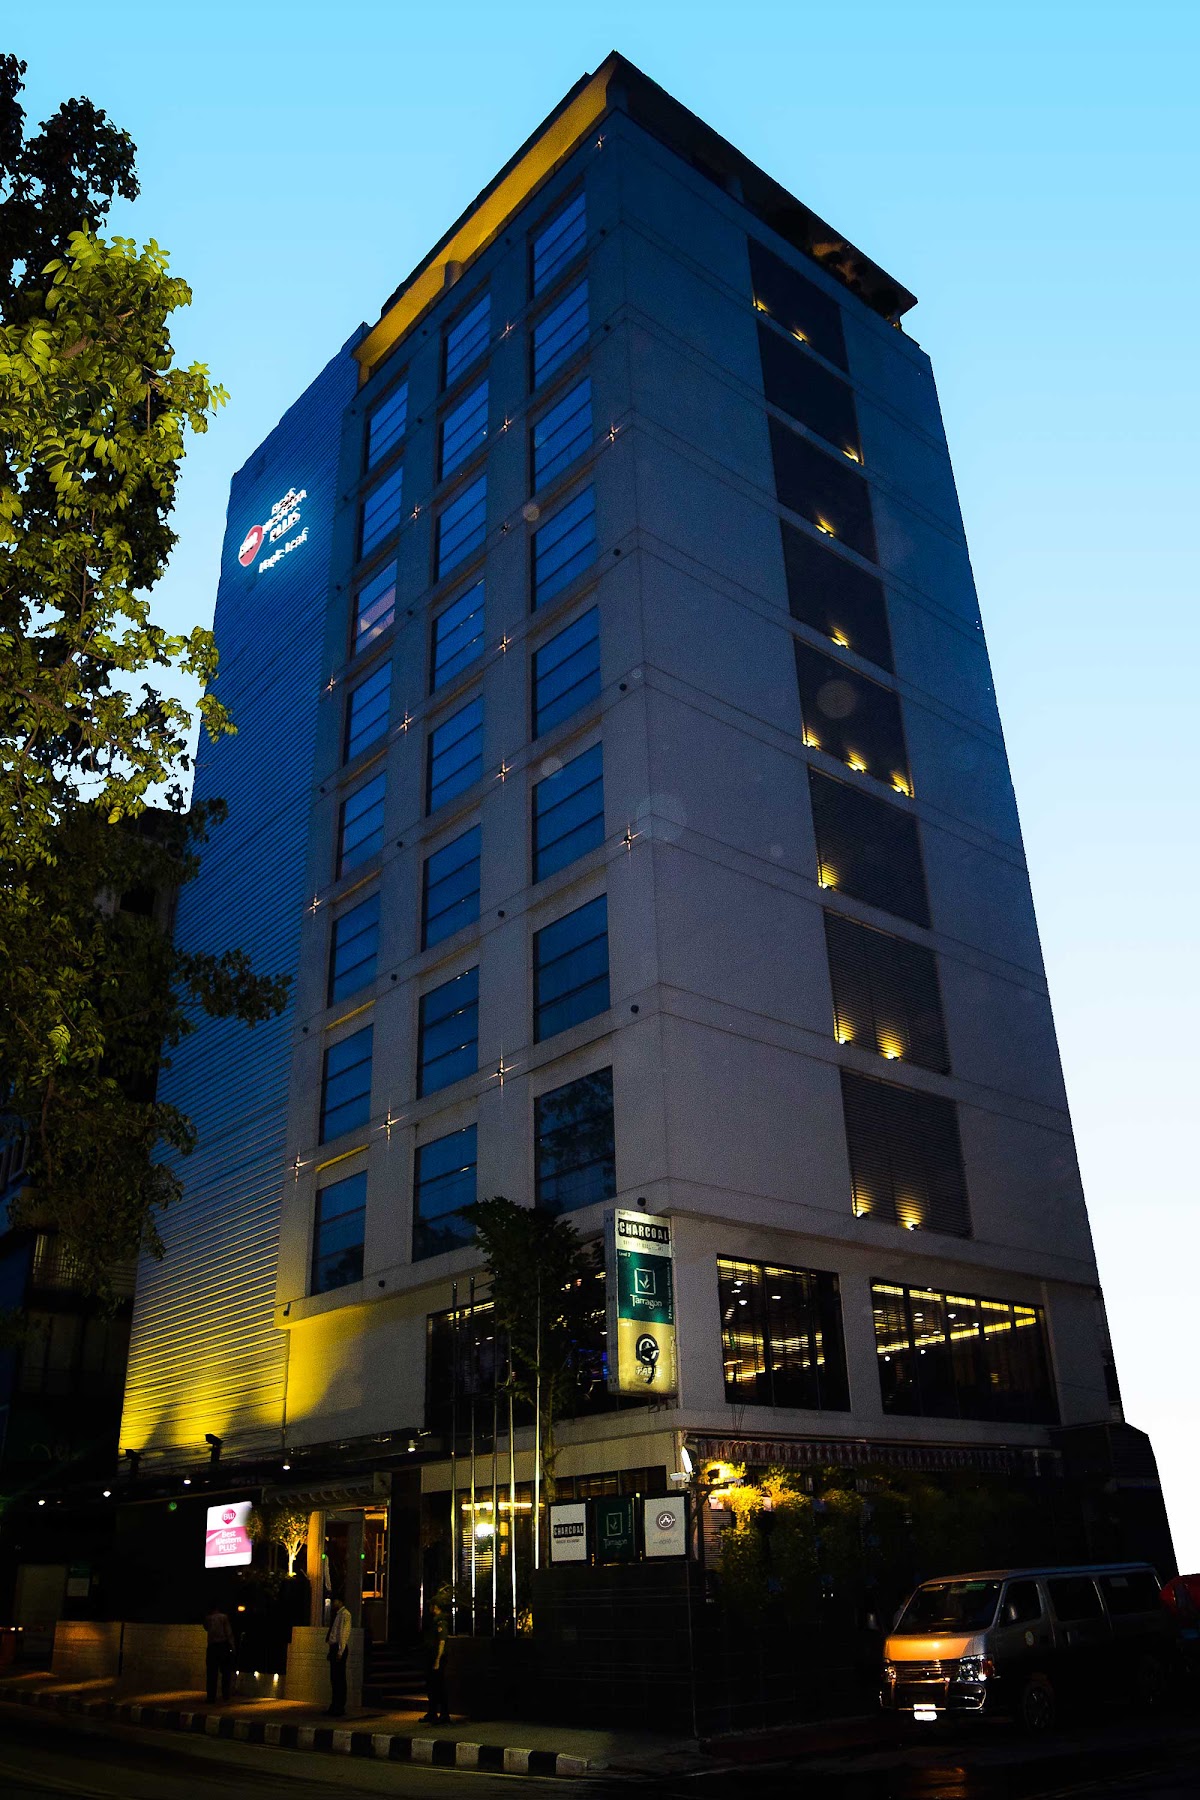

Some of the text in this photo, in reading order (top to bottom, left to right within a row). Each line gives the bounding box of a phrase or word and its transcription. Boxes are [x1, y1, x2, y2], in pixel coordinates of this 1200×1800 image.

[269, 508, 300, 542] PLUS
[619, 1221, 668, 1240] CHARCOAL
[630, 1294, 663, 1310] Tarragon
[553, 1525, 584, 1536] CHARCOAL
[218, 1543, 237, 1552] PLUS
